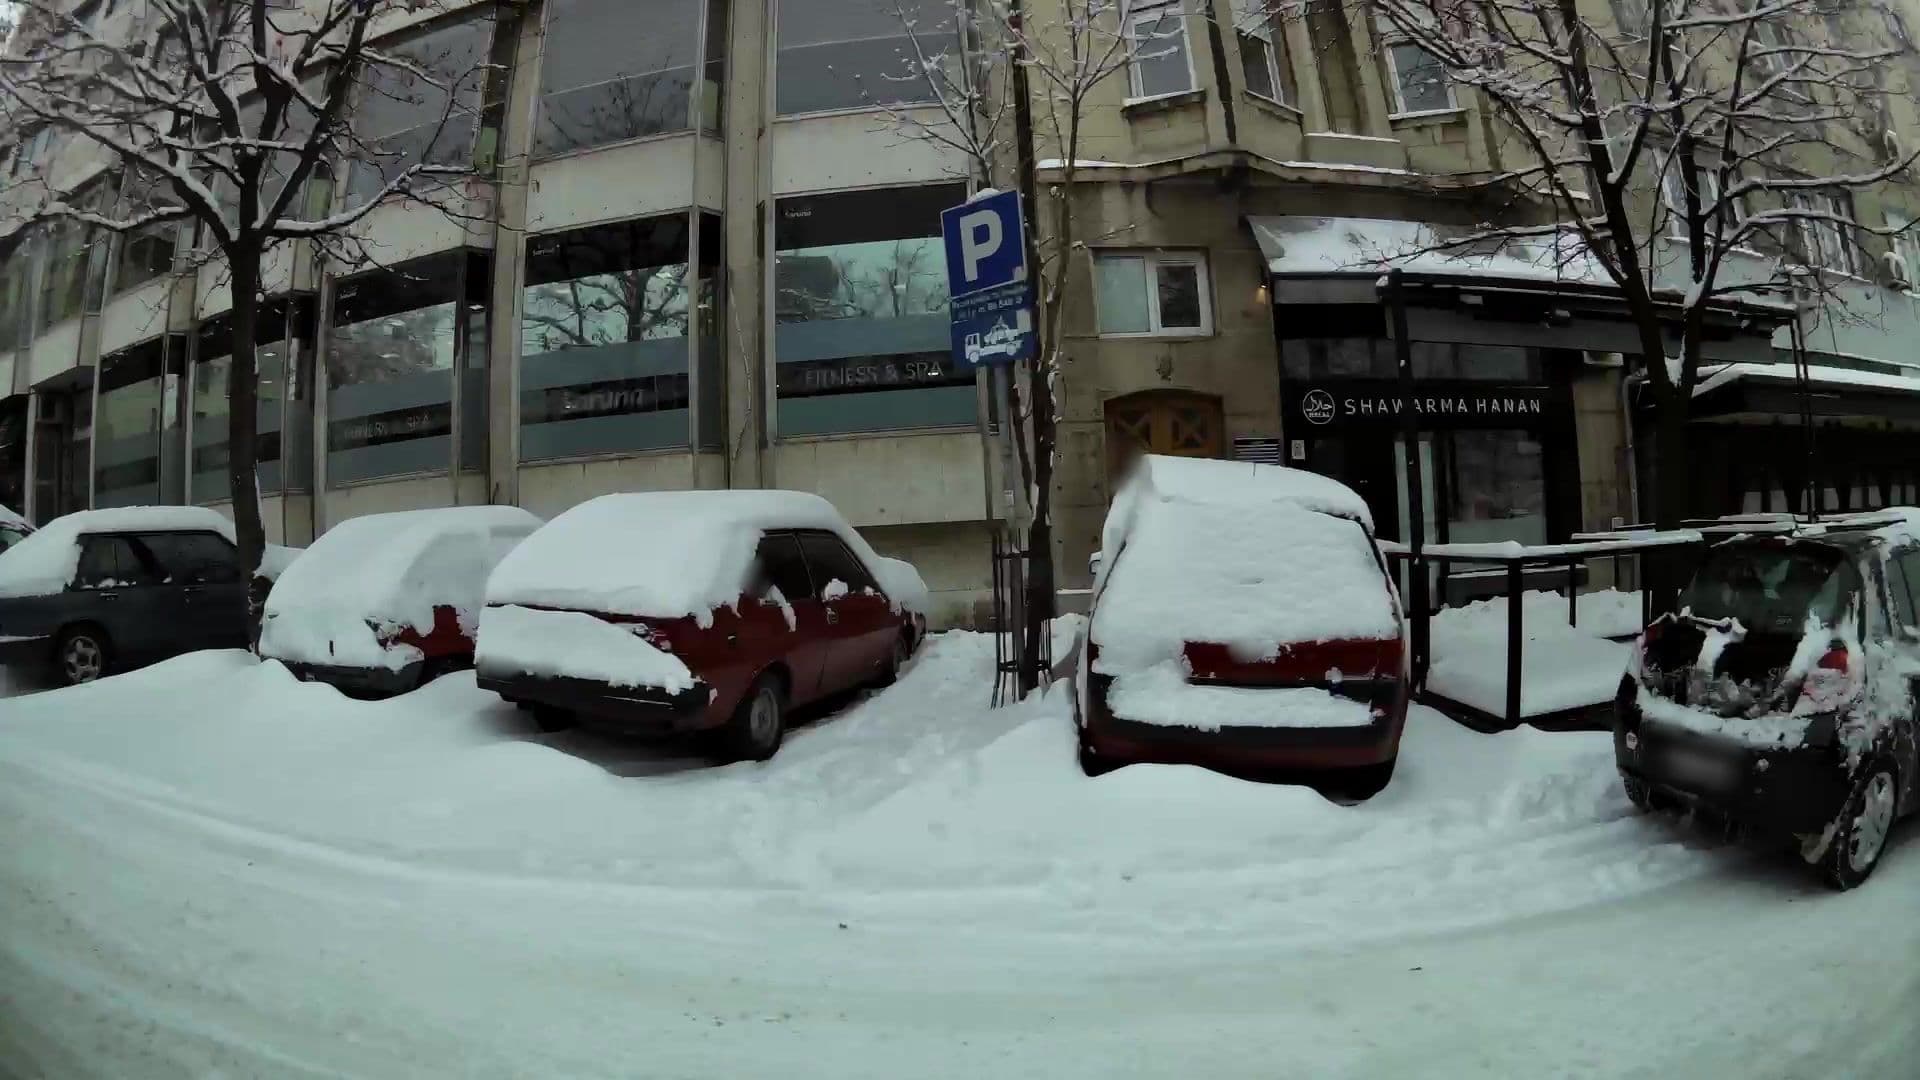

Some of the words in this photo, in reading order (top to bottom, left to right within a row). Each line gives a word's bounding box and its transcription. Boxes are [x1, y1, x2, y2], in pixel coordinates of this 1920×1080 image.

[960, 209, 1002, 282] P
[805, 365, 879, 386] FITNESS
[904, 361, 945, 382] SPA
[1476, 398, 1540, 413] HANAN
